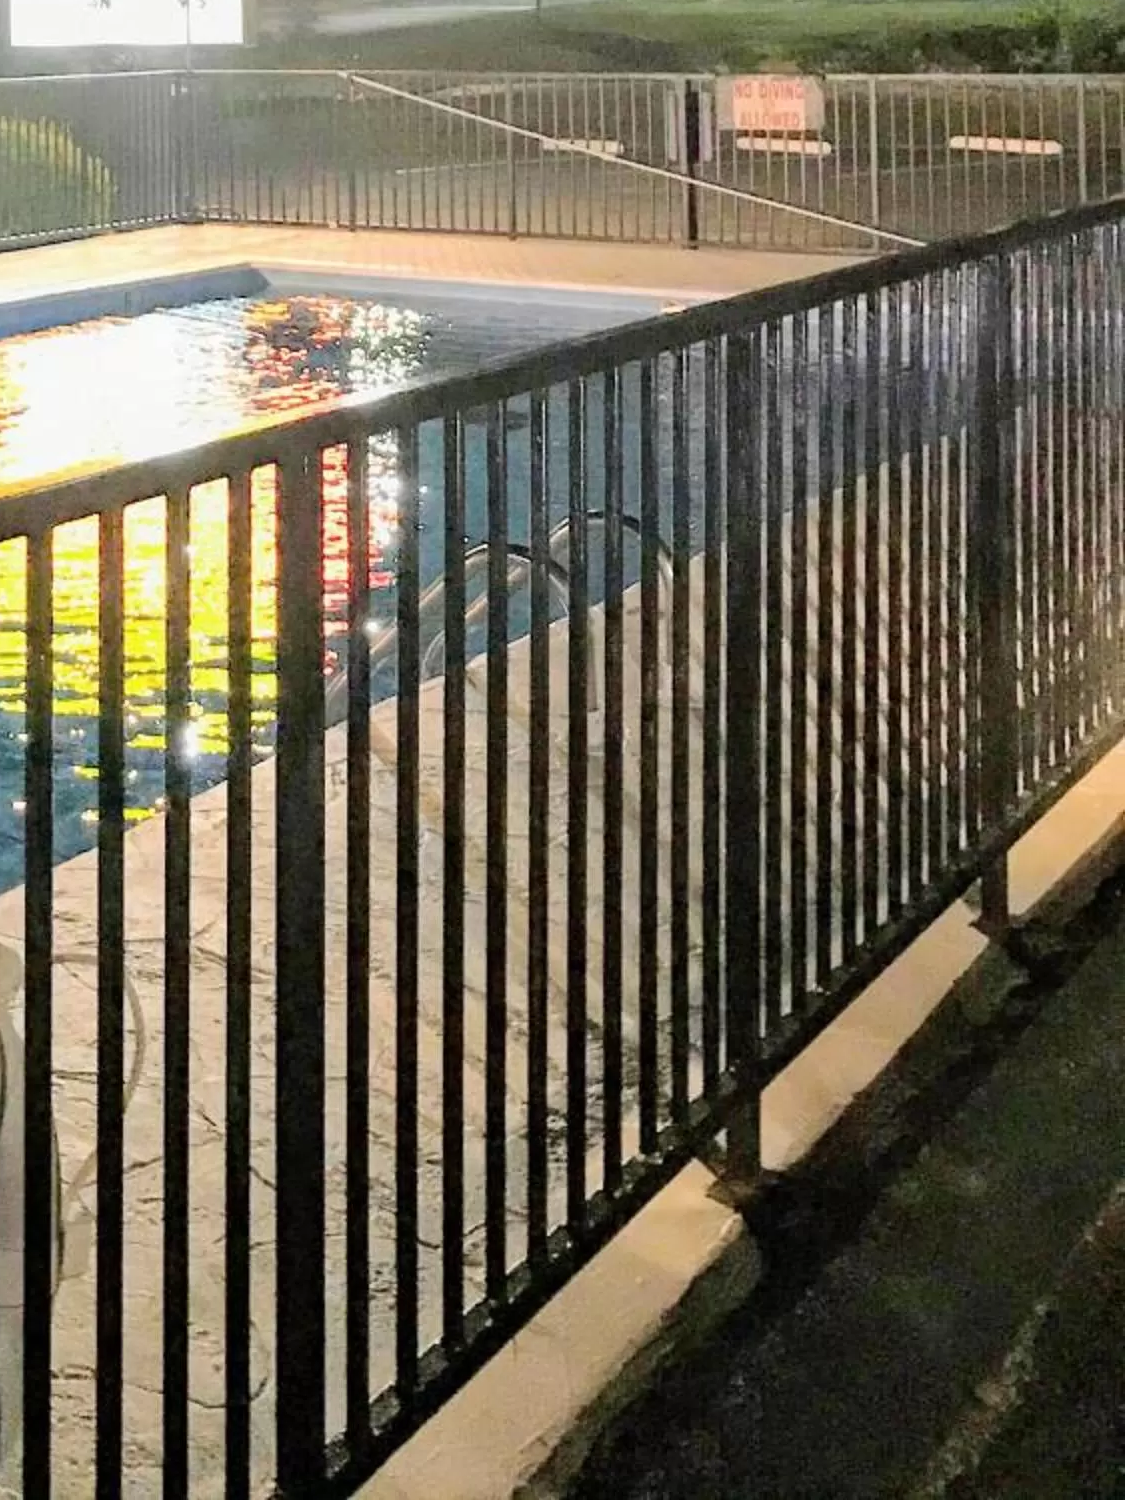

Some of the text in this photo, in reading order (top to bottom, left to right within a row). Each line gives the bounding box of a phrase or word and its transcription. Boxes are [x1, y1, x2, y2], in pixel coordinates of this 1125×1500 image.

[735, 83, 804, 99] NO DIVING
[740, 111, 800, 127] ALLOWED
